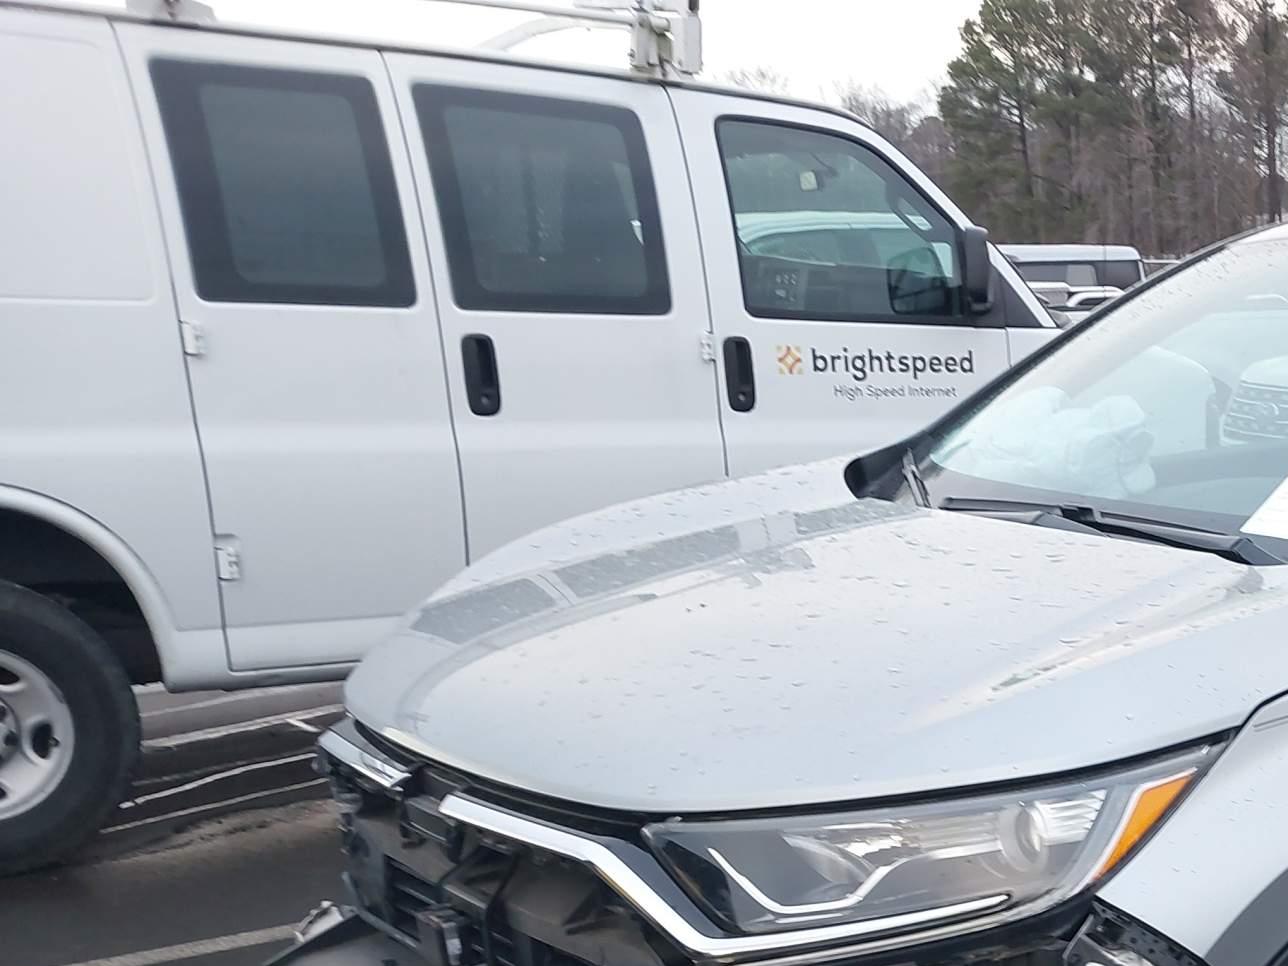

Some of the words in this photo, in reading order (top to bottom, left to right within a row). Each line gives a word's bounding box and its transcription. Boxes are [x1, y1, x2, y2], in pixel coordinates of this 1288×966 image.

[811, 348, 974, 381] brightspeed
[833, 384, 864, 401] High
[867, 385, 905, 400] Speed
[908, 385, 958, 398] Internet
